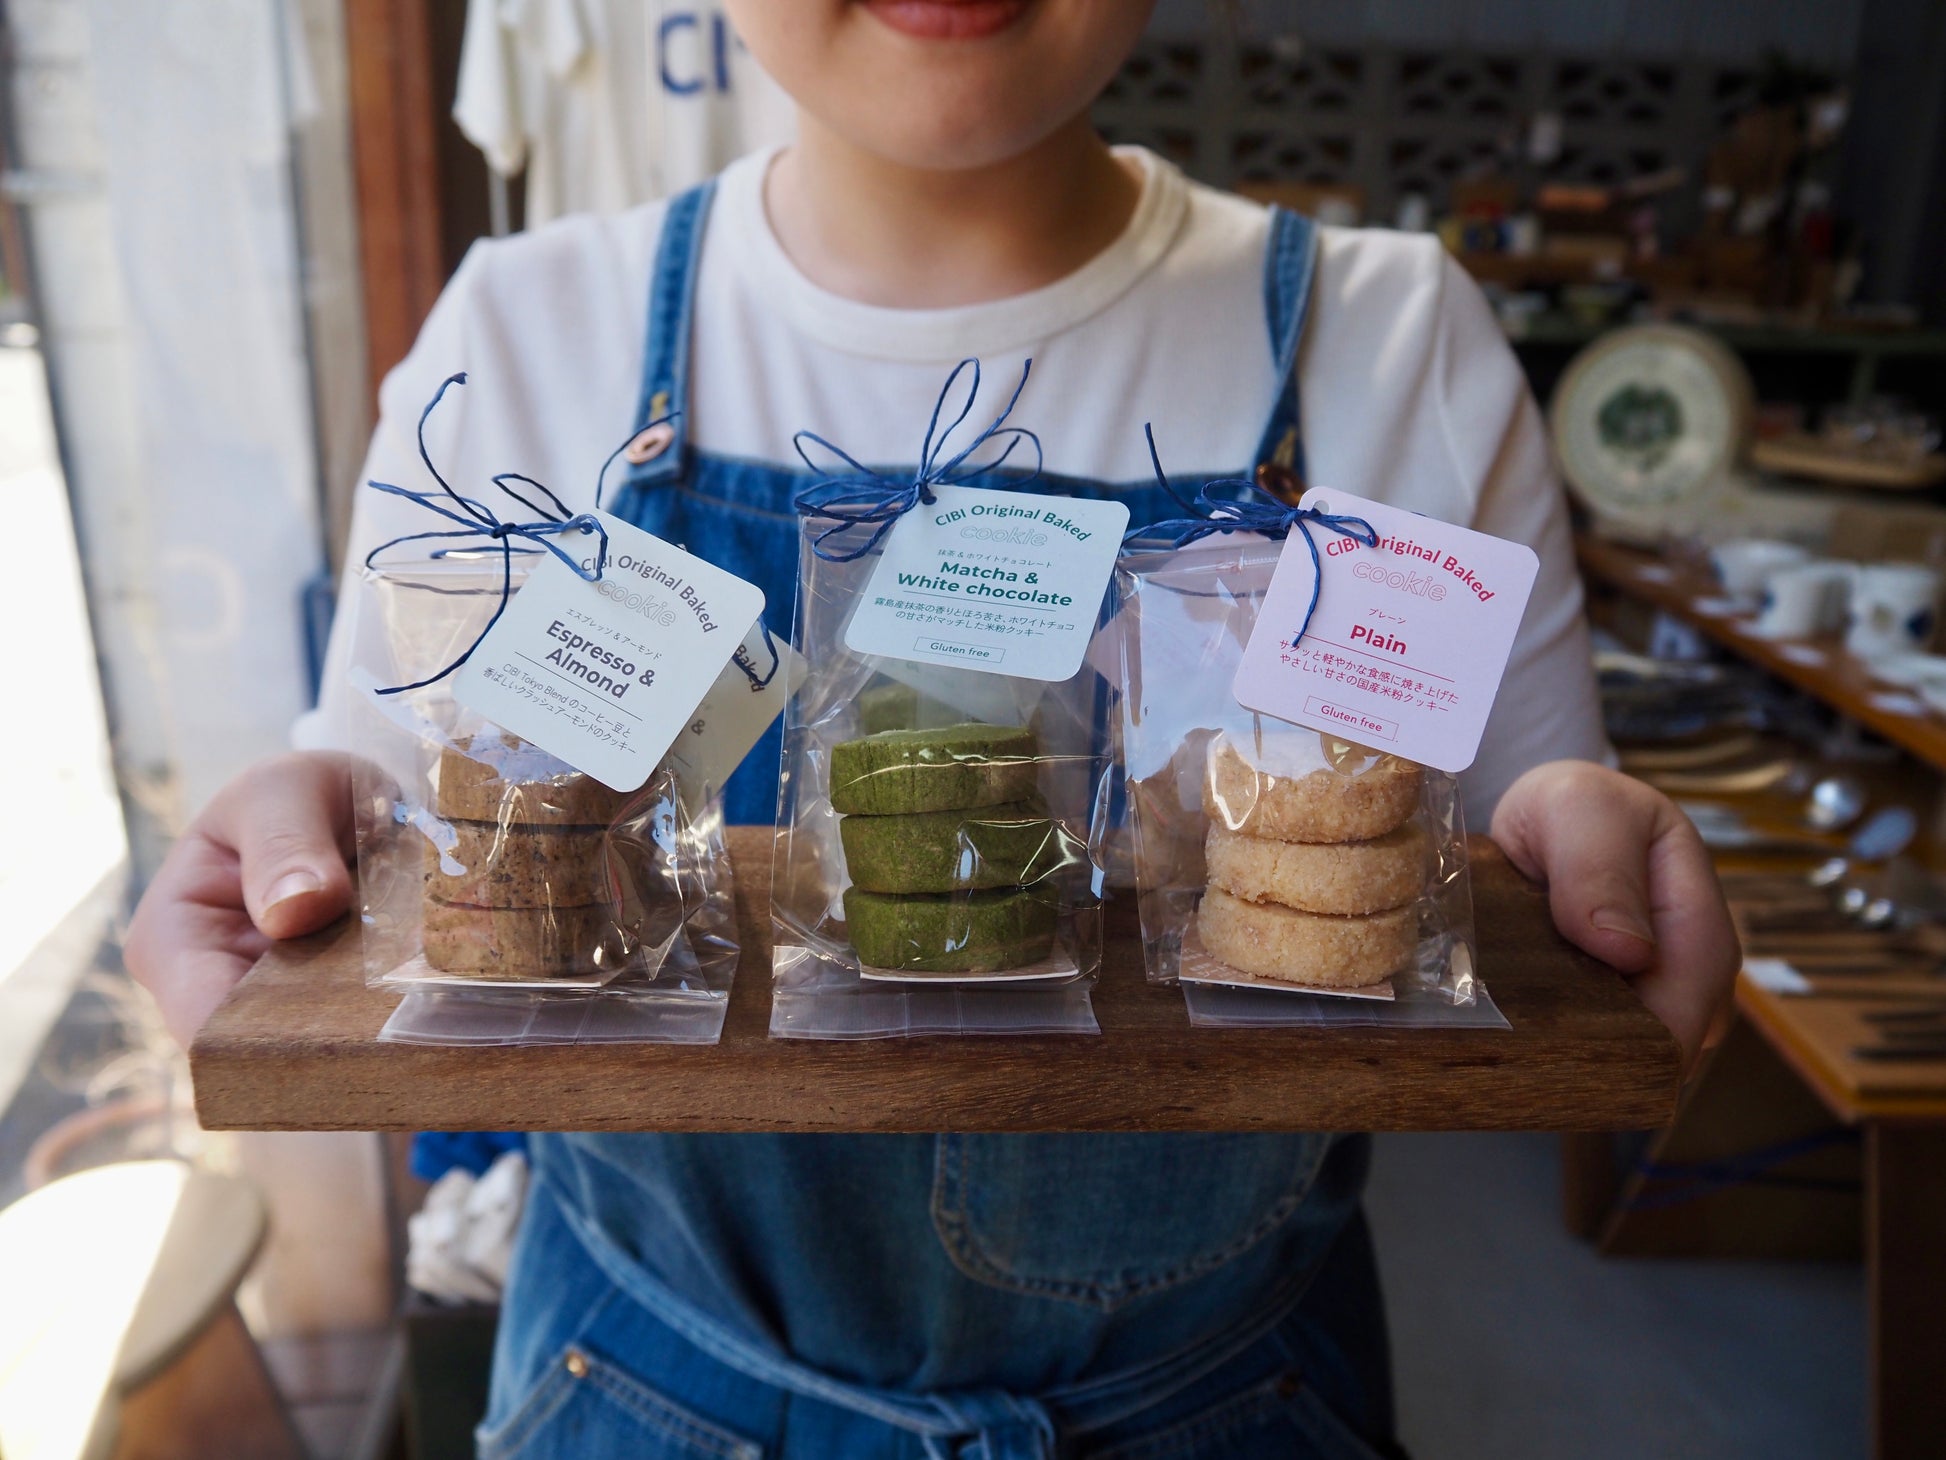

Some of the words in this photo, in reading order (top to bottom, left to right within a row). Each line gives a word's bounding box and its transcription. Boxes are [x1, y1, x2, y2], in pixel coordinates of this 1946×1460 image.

[935, 508, 967, 526] CIBI
[971, 504, 1041, 520] Original
[1043, 512, 1092, 542] Baked
[960, 525, 1049, 547] cookie
[940, 561, 1018, 583] Matcha
[1024, 572, 1039, 585] &
[1326, 537, 1360, 557] CIBI
[1442, 555, 1495, 602] Baked
[1353, 561, 1447, 601] cookie
[597, 579, 678, 627] cookie
[618, 555, 683, 591] Original
[679, 585, 718, 633] Baked
[898, 573, 960, 592] White
[966, 583, 1073, 606] chocolate
[1368, 608, 1406, 624] プレーン
[546, 619, 636, 676] Espresso
[638, 669, 655, 687] &
[930, 641, 966, 655] Gluten
[968, 647, 990, 658] free
[1350, 624, 1408, 655] Plain
[502, 663, 520, 677] CIBI
[521, 672, 543, 691] Tokyo
[544, 686, 569, 704] Blend
[545, 648, 630, 698] Almond
[1280, 654, 1449, 712] やさしい甘さの国産米粉クッキー
[1321, 705, 1358, 725] Gluten
[1360, 716, 1383, 732] free
